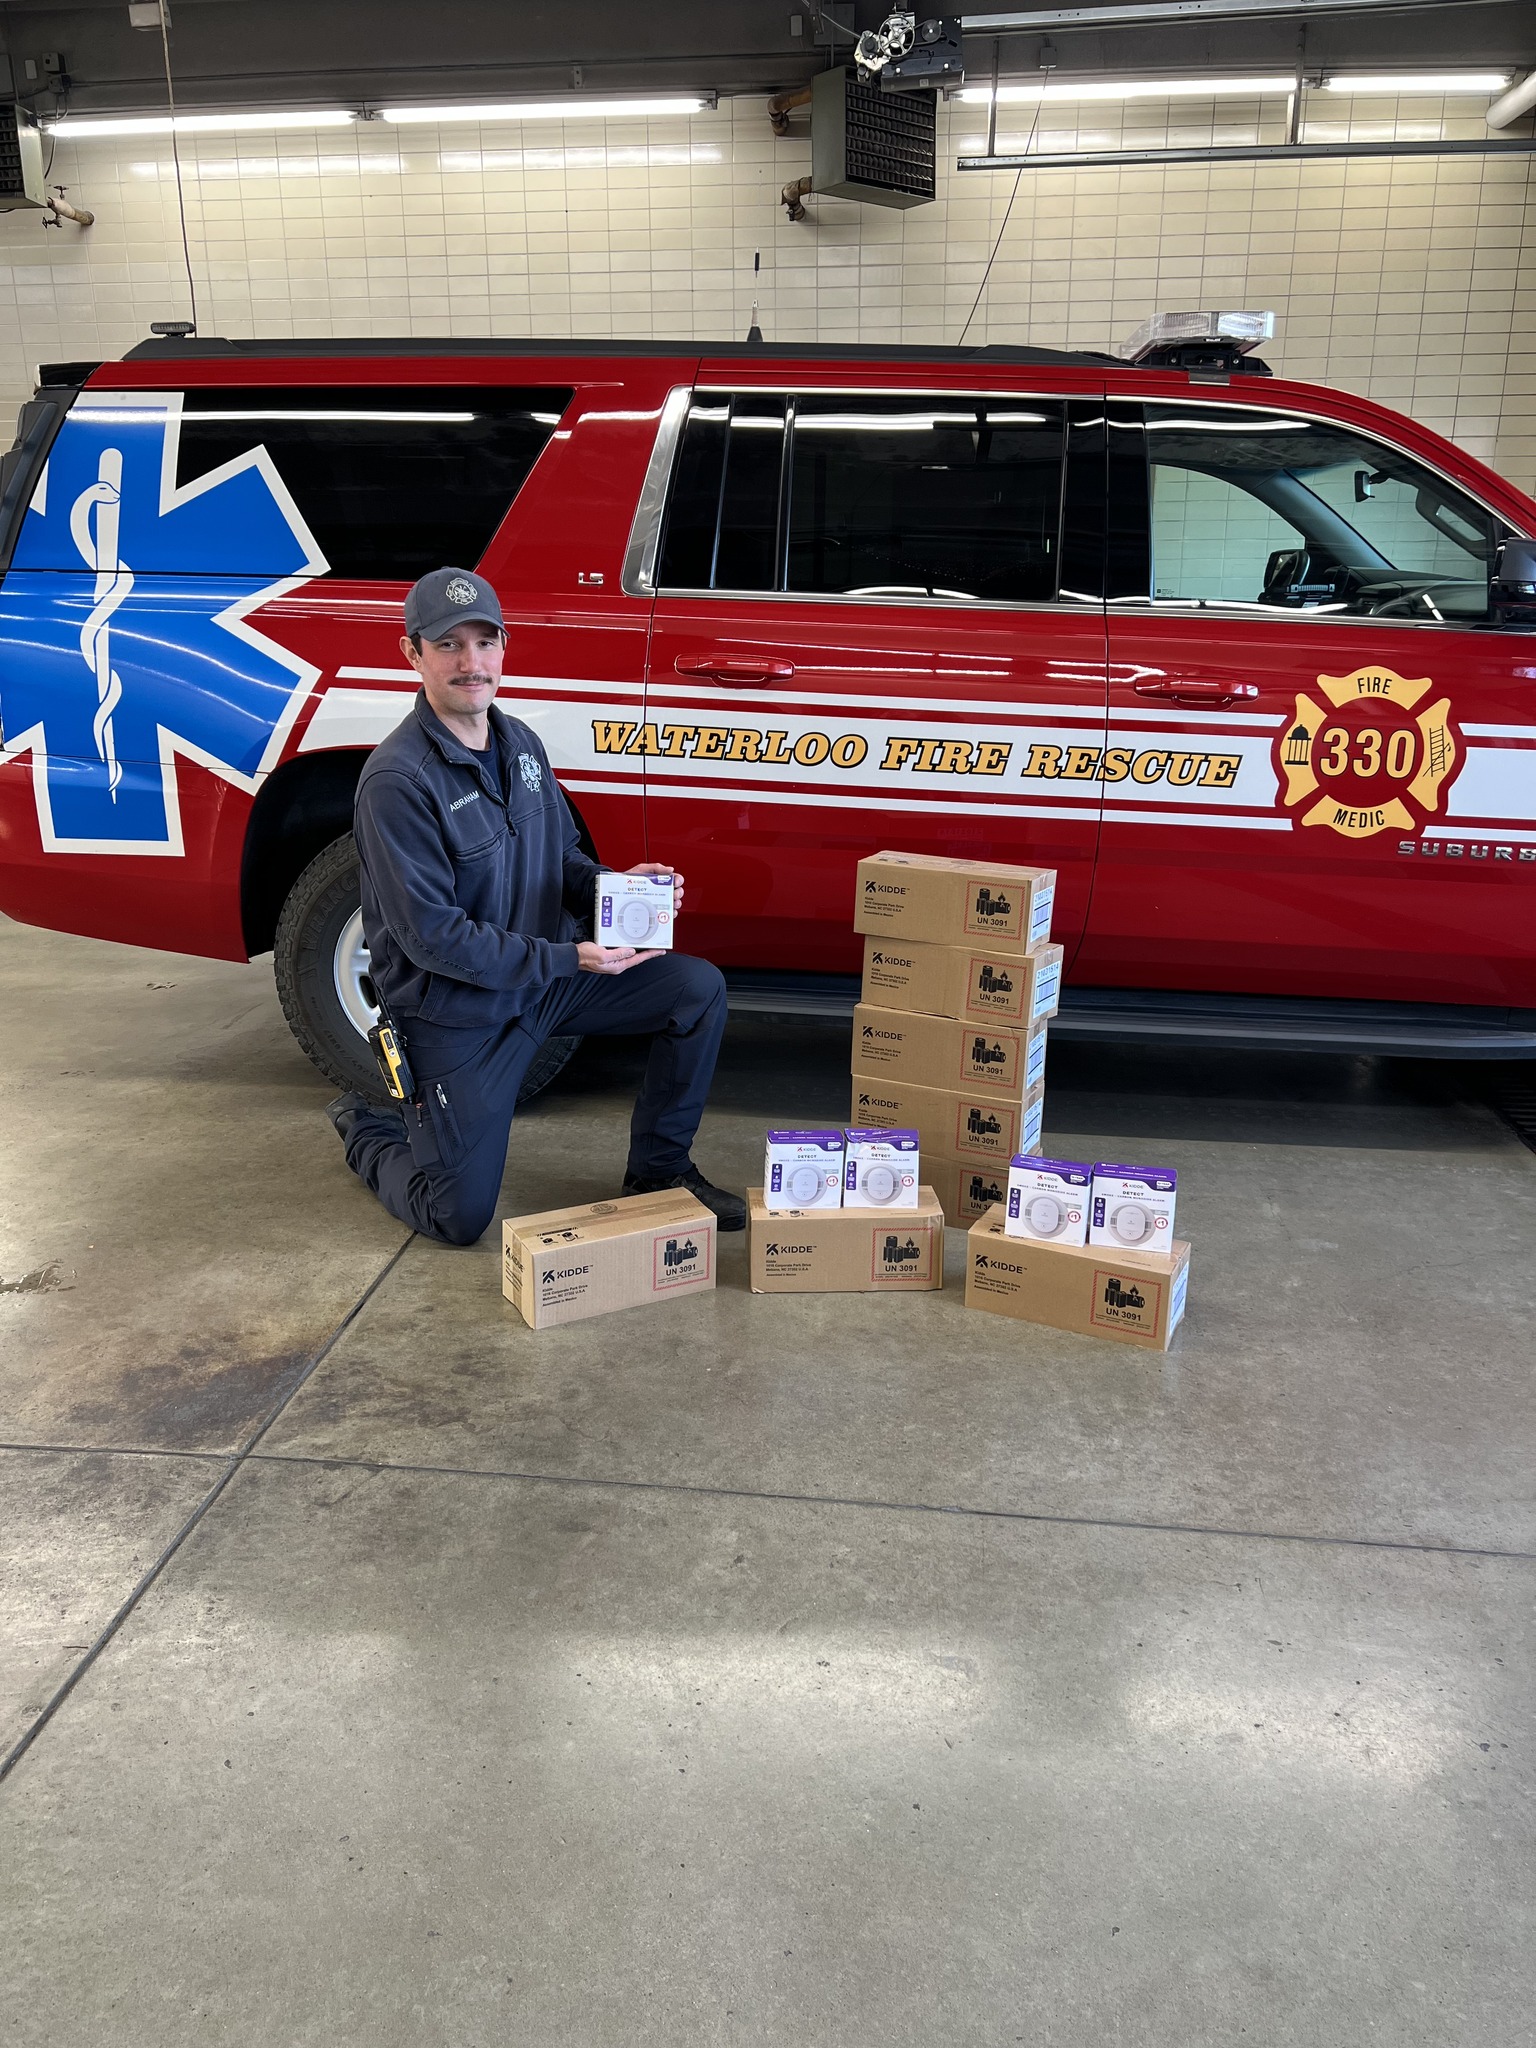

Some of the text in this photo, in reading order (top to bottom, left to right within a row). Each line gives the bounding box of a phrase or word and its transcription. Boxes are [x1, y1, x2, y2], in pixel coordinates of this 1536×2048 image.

[579, 572, 603, 585] LS
[1357, 677, 1392, 694] FIRE
[592, 720, 1243, 788] WATERLOO FIRE RESCUE
[1319, 727, 1417, 779] 330
[449, 790, 480, 812] ABRAHAM
[1333, 808, 1385, 828] MEDIC
[878, 885, 906, 895] KIDDE
[990, 919, 1008, 927] 3091
[884, 957, 911, 968] KIDDE
[992, 996, 1009, 1004] 3091
[875, 1030, 903, 1041] KIDDE
[986, 1066, 1003, 1075] 3091
[871, 1098, 899, 1109] KIDDE
[981, 1137, 998, 1145] 3091
[557, 1265, 589, 1279] KIDDE
[666, 1264, 696, 1276] UN 3091
[990, 1260, 1023, 1274] KIDDE
[1106, 1308, 1119, 1316] UN
[1121, 1311, 1141, 1321] 3091
